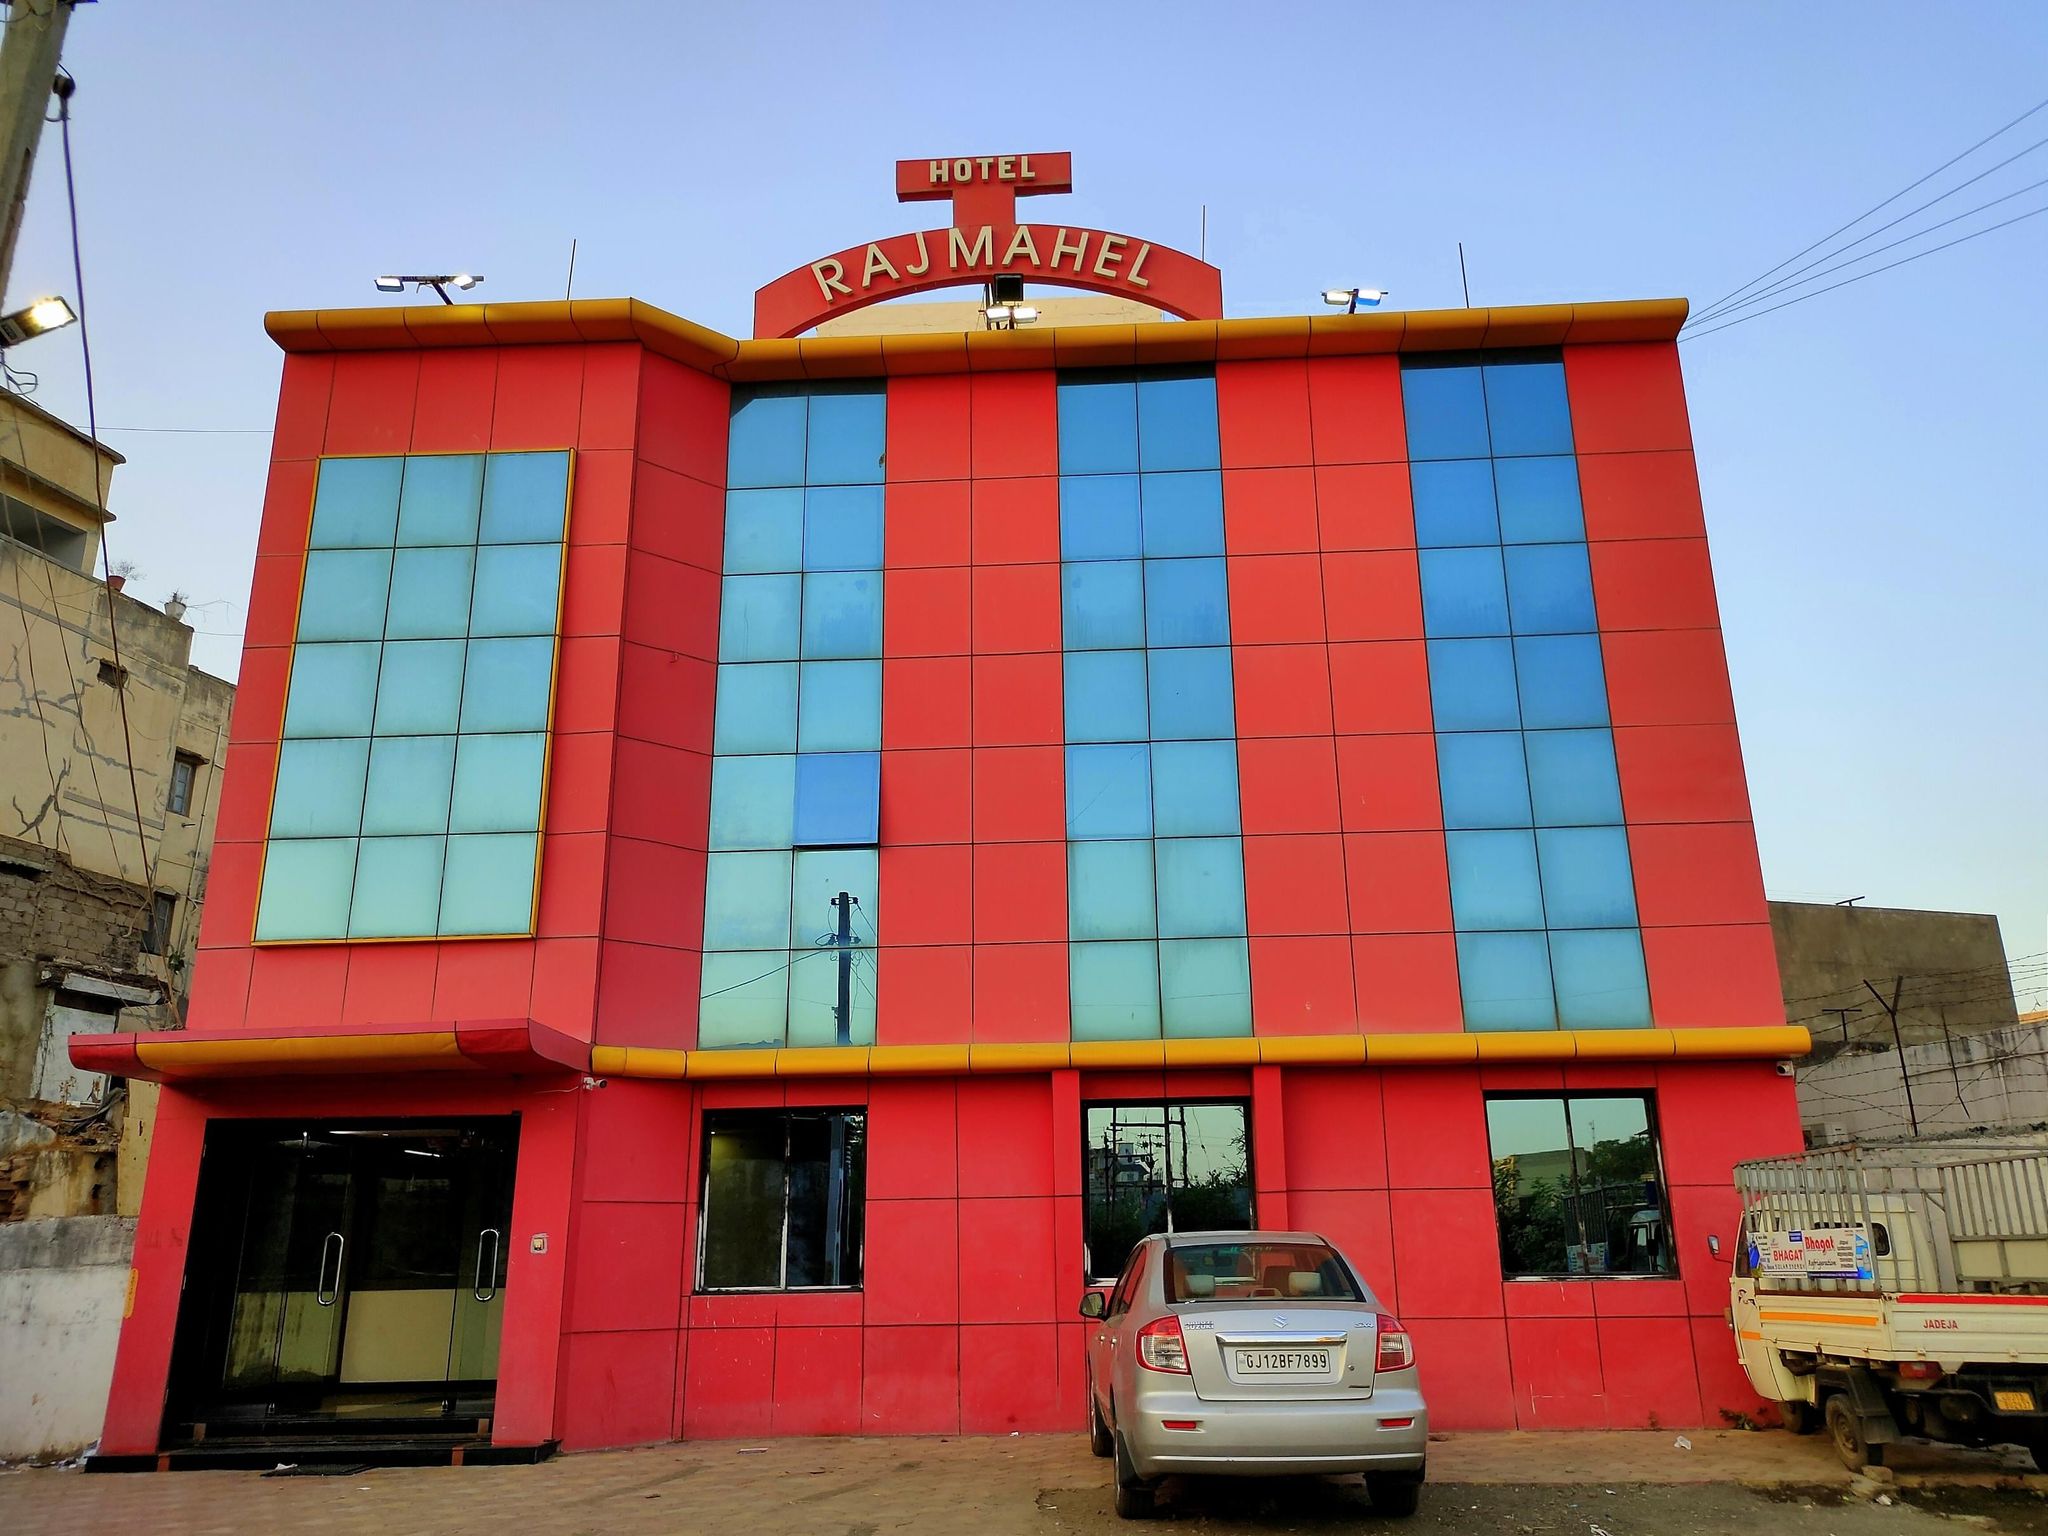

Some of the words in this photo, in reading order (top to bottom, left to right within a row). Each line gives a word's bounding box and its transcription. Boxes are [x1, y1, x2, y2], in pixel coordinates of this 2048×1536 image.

[929, 155, 1036, 184] HOTEL
[1804, 1236, 1835, 1253] Bhagat
[1773, 1250, 1803, 1261] BHAGAT
[1923, 1319, 1958, 1329] JADEJA
[1246, 1354, 1327, 1369] GJ12BF7899
